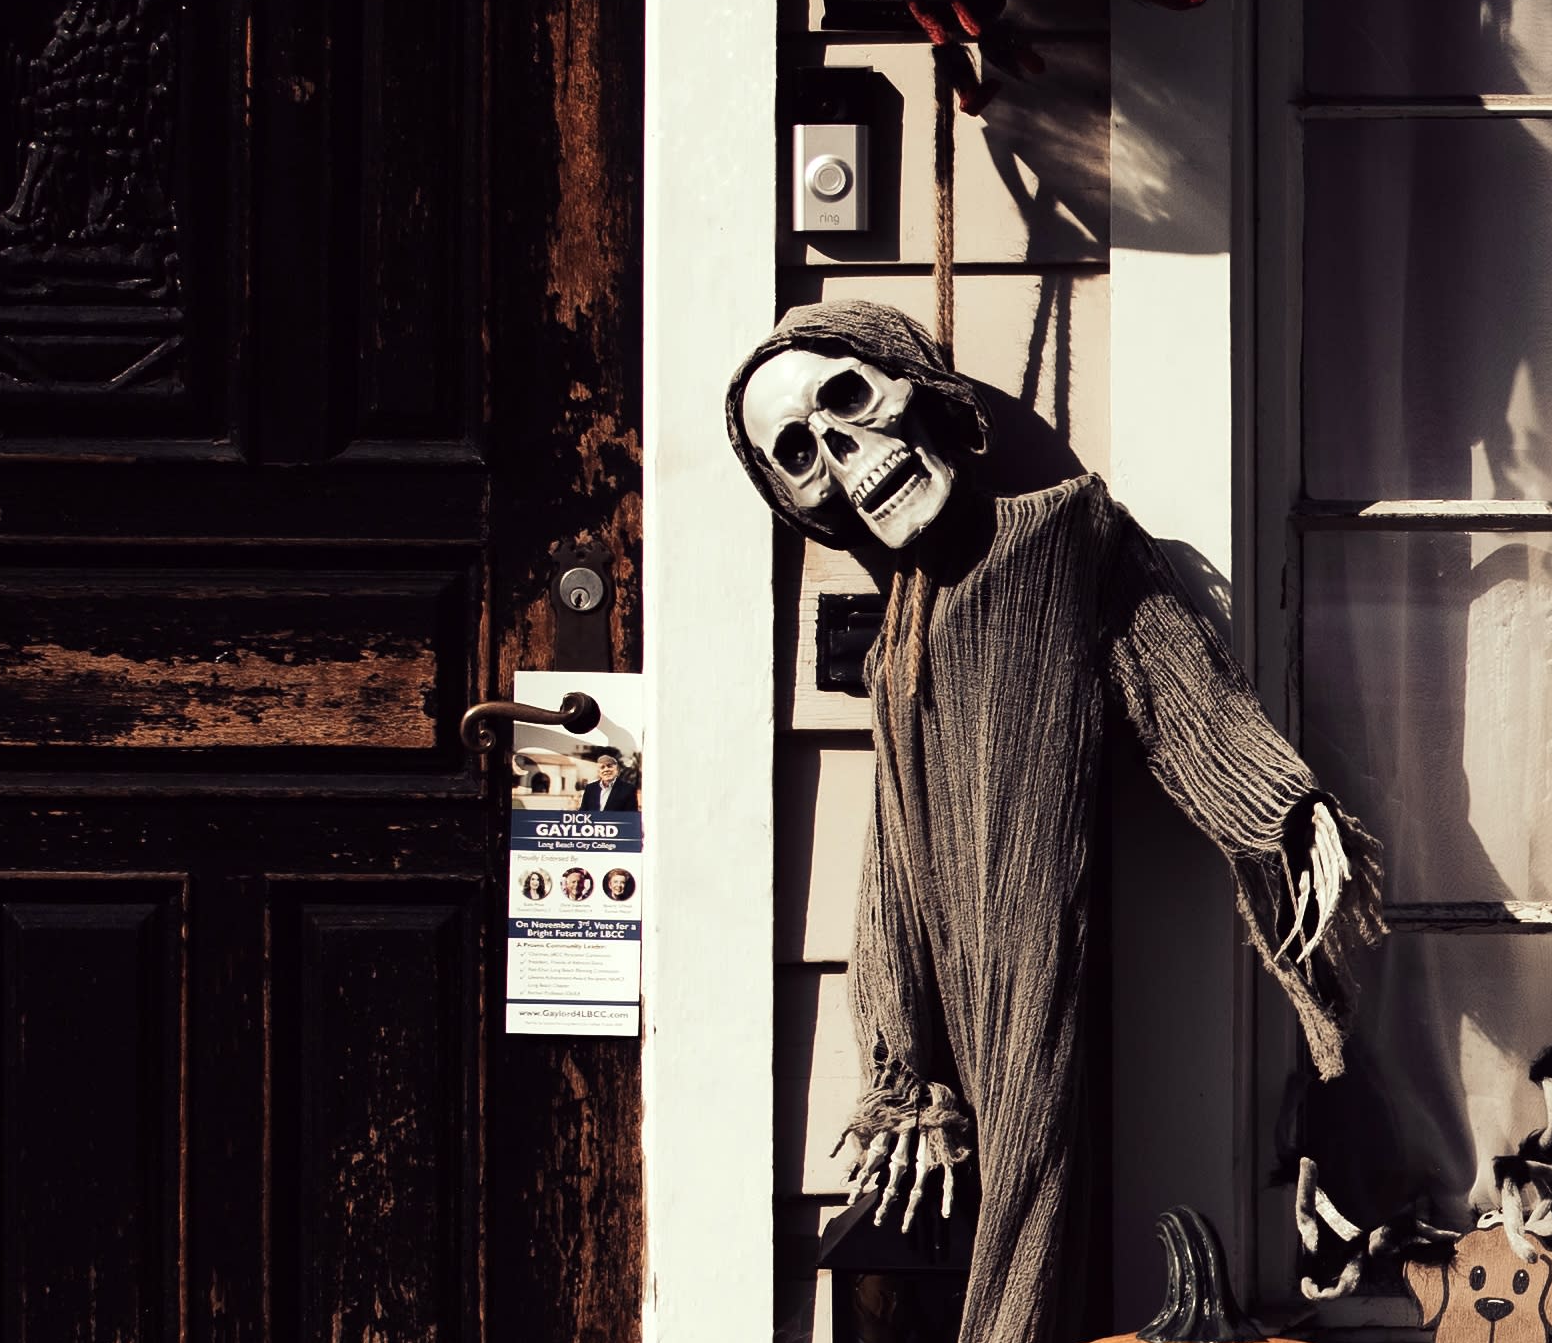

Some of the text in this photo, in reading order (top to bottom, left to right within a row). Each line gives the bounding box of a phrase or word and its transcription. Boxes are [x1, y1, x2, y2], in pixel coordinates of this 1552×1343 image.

[819, 212, 840, 226] ring
[563, 813, 592, 824] DICK
[536, 824, 619, 837] GAYLORD
[538, 841, 554, 849] Long
[576, 842, 590, 850] City
[592, 842, 616, 850] College
[531, 921, 575, 929] November
[594, 922, 614, 930] Vote
[616, 923, 630, 931] for
[527, 929, 553, 938] Bright
[555, 930, 583, 938] Future
[585, 930, 598, 938] for
[519, 1009, 629, 1019] www.Gaylord4LBCC.com
